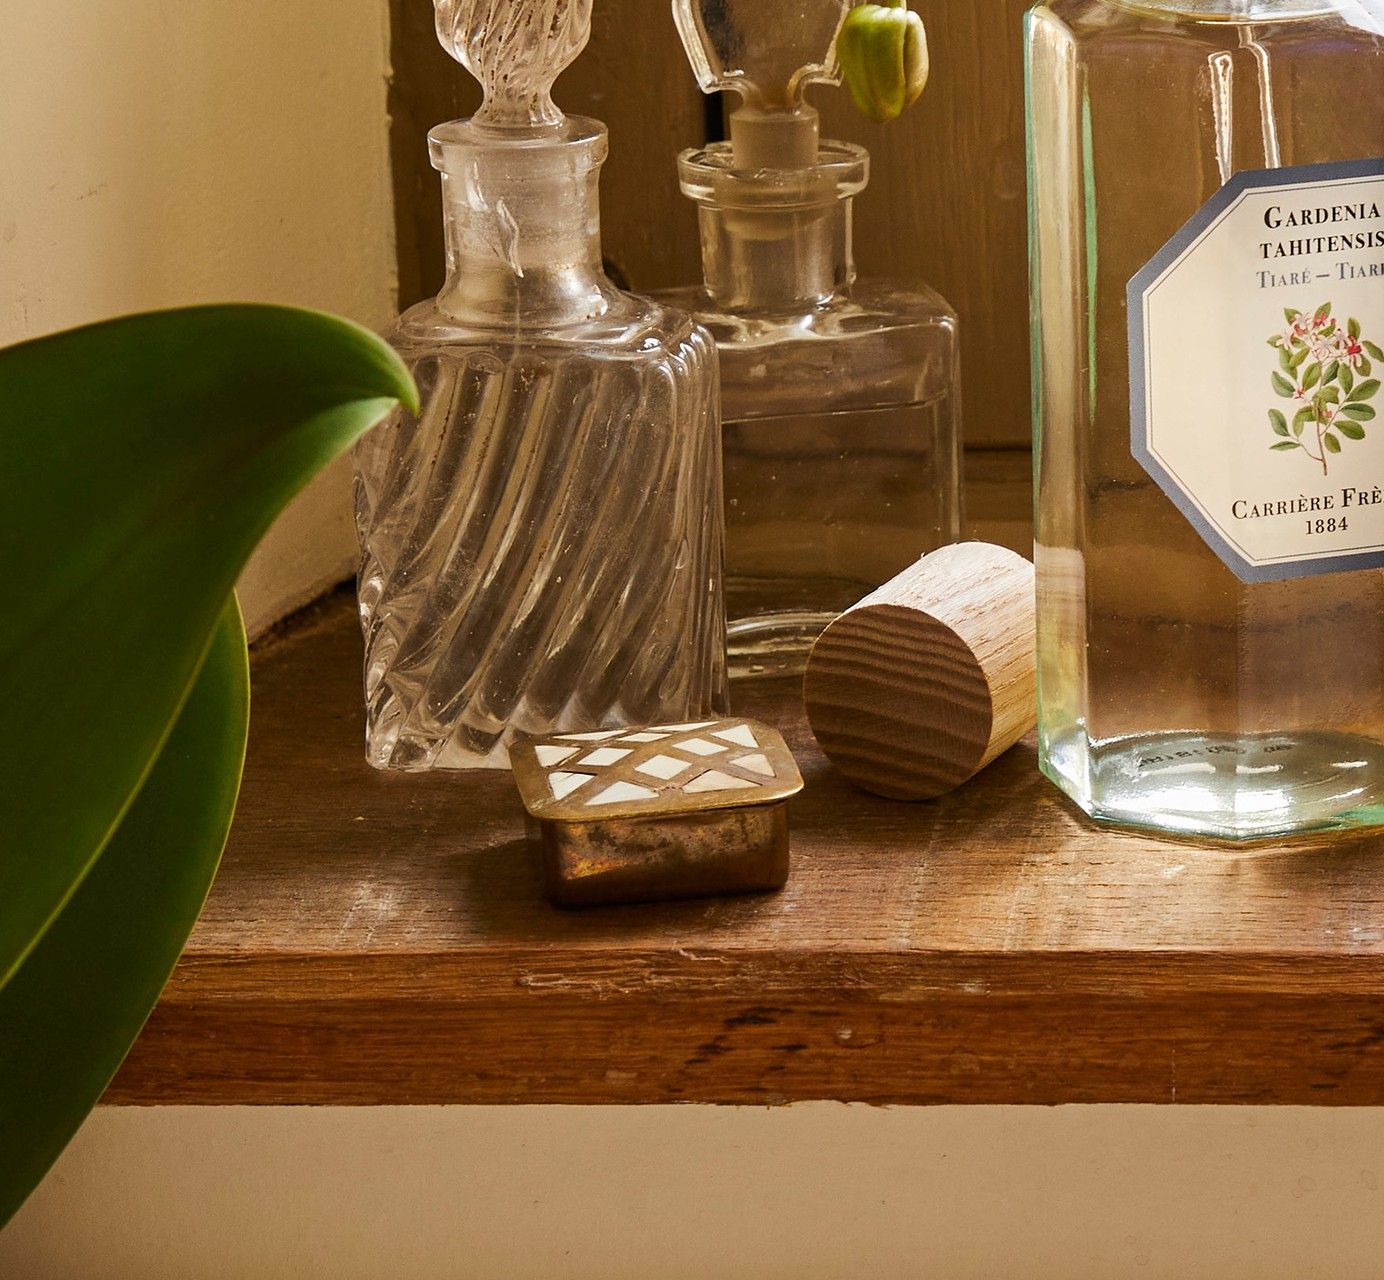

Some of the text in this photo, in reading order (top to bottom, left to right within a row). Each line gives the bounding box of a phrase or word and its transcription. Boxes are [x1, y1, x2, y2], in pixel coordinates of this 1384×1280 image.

[1264, 202, 1381, 229] GARDENIA
[1257, 267, 1311, 289] TIARÉ
[1231, 494, 1335, 520] CARRIÈRE
[1305, 516, 1349, 535] 1884
